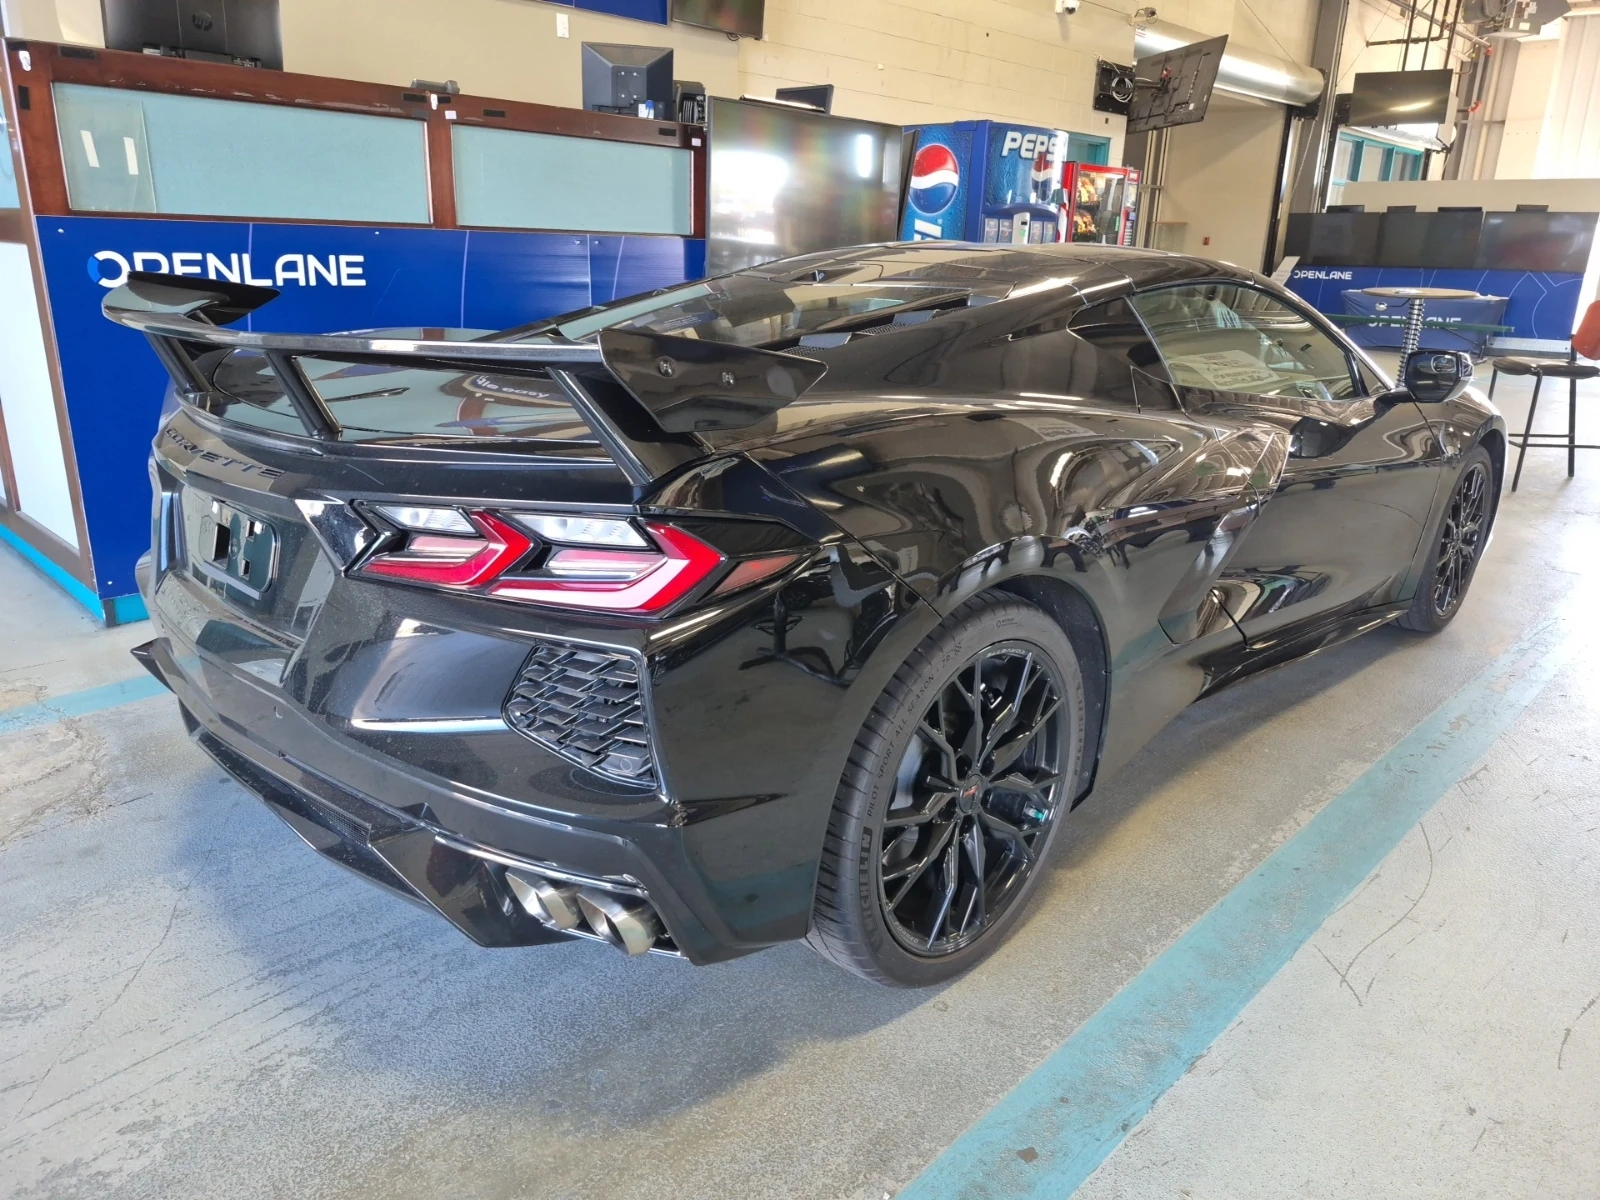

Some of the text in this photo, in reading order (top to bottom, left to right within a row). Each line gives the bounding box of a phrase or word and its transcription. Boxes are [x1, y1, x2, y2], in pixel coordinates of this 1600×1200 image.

[1001, 131, 1060, 161] PEPS
[1293, 270, 1353, 280] OPENLANE
[165, 427, 287, 479] CORVETTE
[867, 783, 880, 817] PILOT
[877, 741, 895, 780] SPORT
[895, 718, 908, 738] ALL
[907, 673, 935, 715] SEASON
[859, 829, 877, 932] MICHELIN
